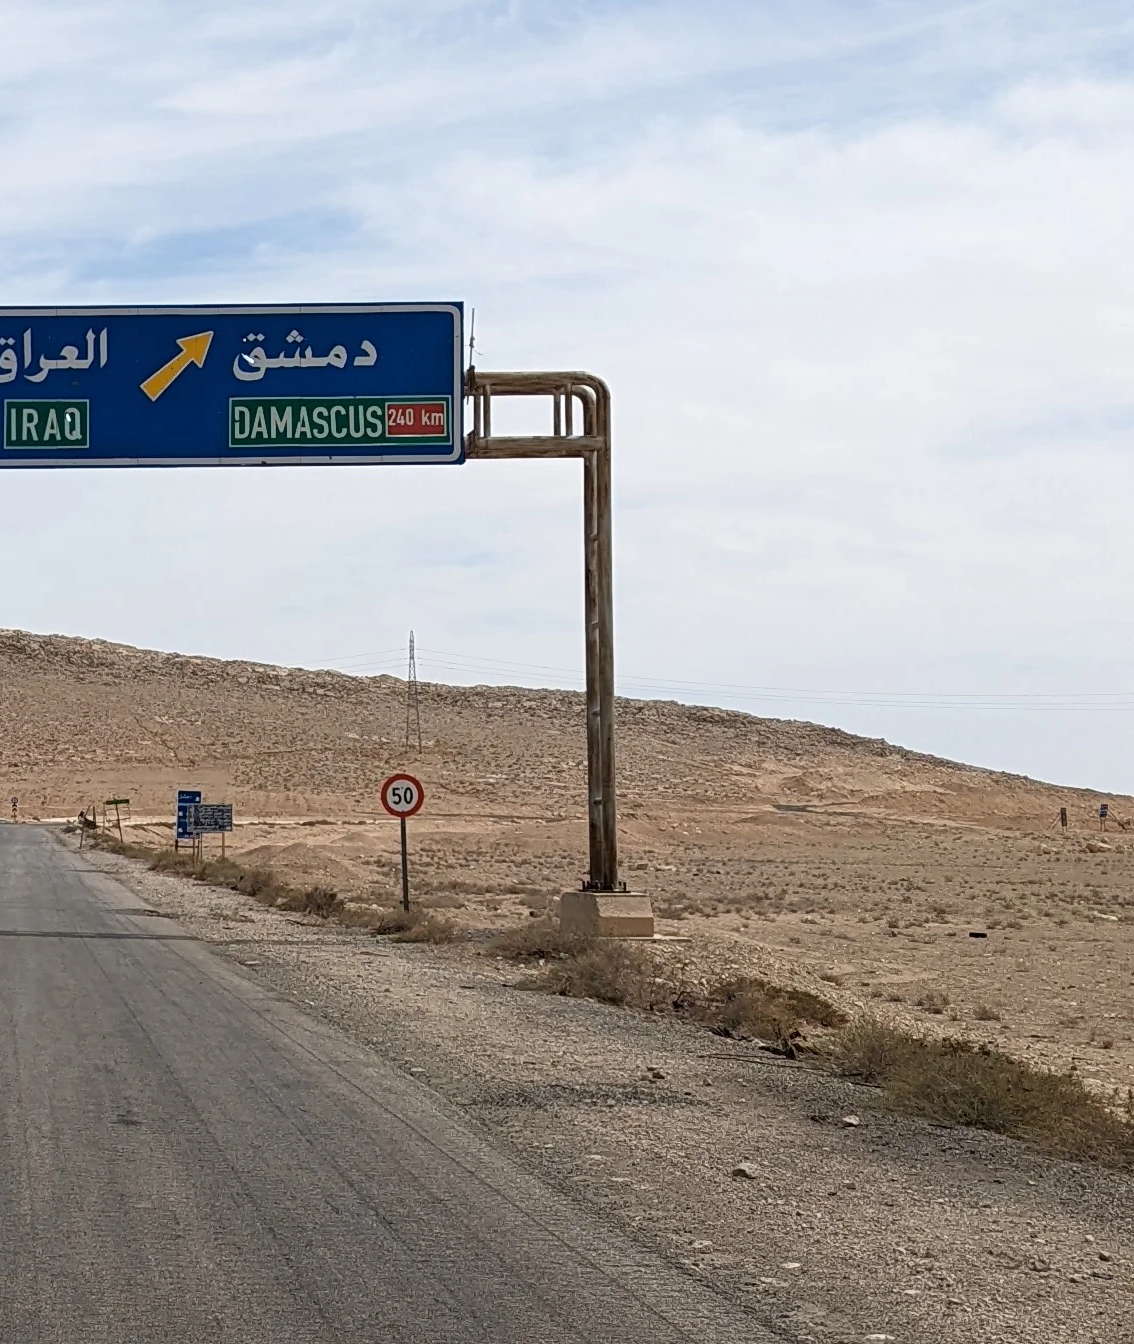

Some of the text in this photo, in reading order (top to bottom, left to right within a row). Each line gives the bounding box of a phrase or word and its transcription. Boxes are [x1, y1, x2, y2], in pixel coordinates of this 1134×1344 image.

[233, 329, 378, 381] دمشق
[10, 407, 82, 441] IRAQ
[234, 405, 444, 439] DAMASCUS 240 km
[392, 787, 413, 805] 50
